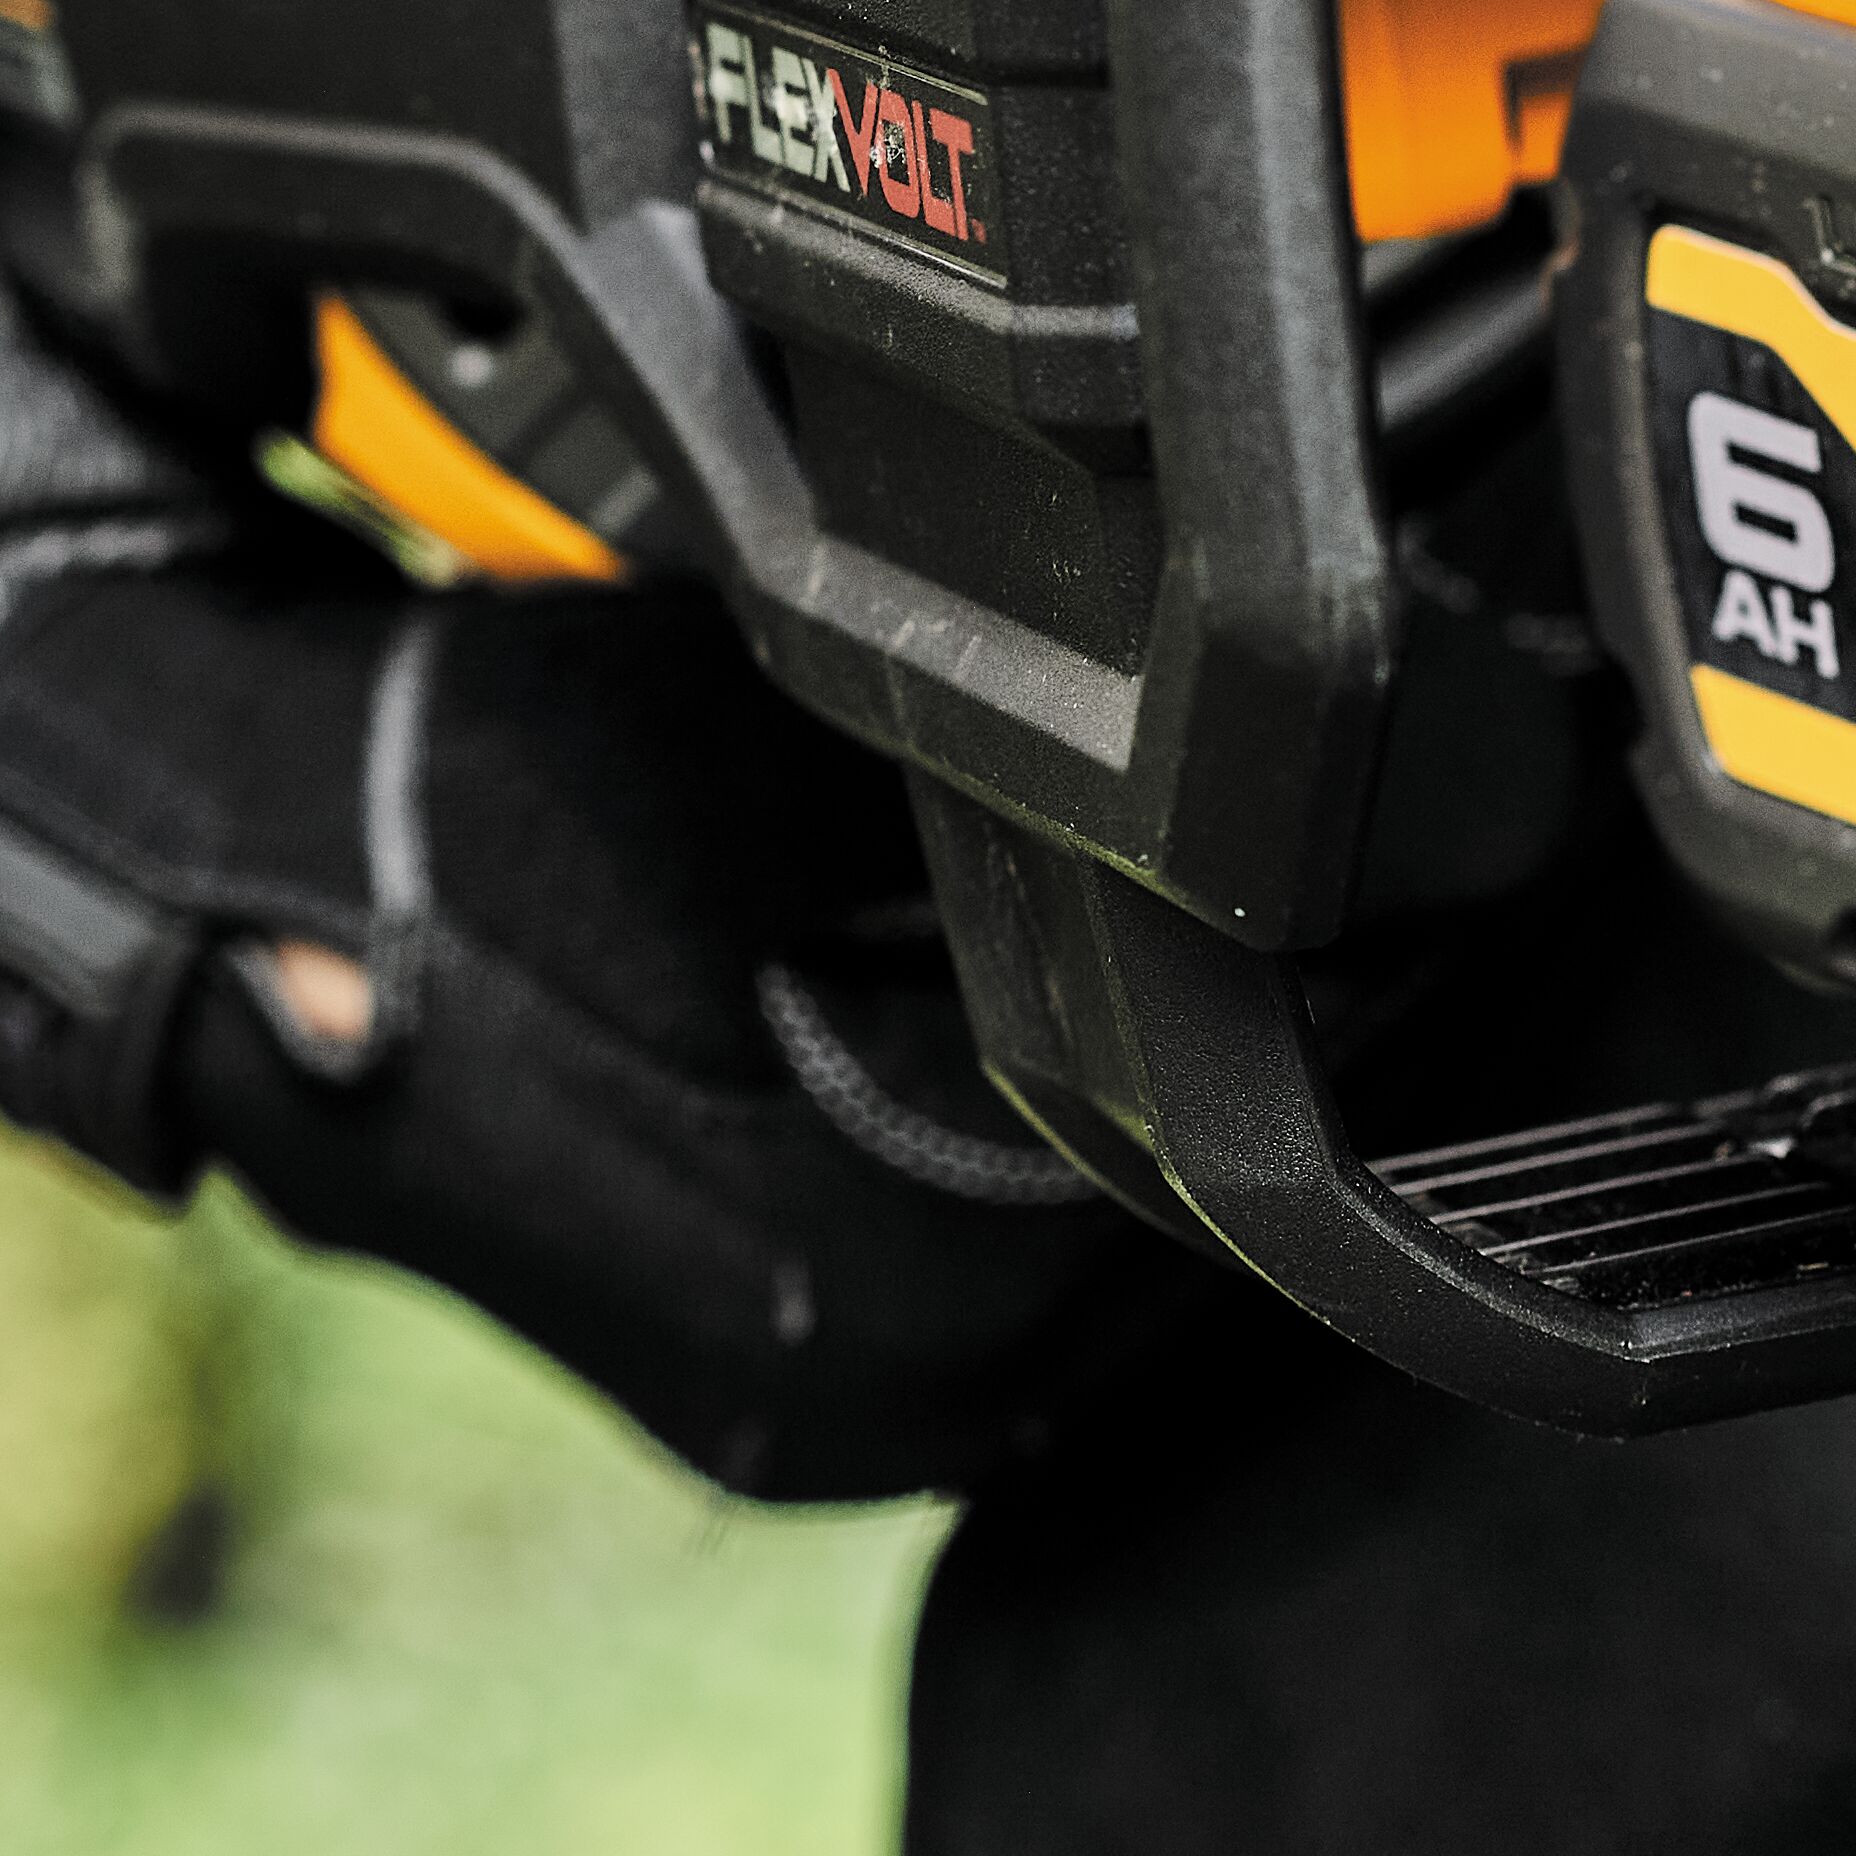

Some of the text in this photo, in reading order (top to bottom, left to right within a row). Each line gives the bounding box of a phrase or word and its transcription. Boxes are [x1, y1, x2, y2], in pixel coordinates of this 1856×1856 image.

[705, 22, 976, 242] FLEXVOLT
[1687, 391, 1836, 594] 6
[1711, 569, 1840, 680] AH
